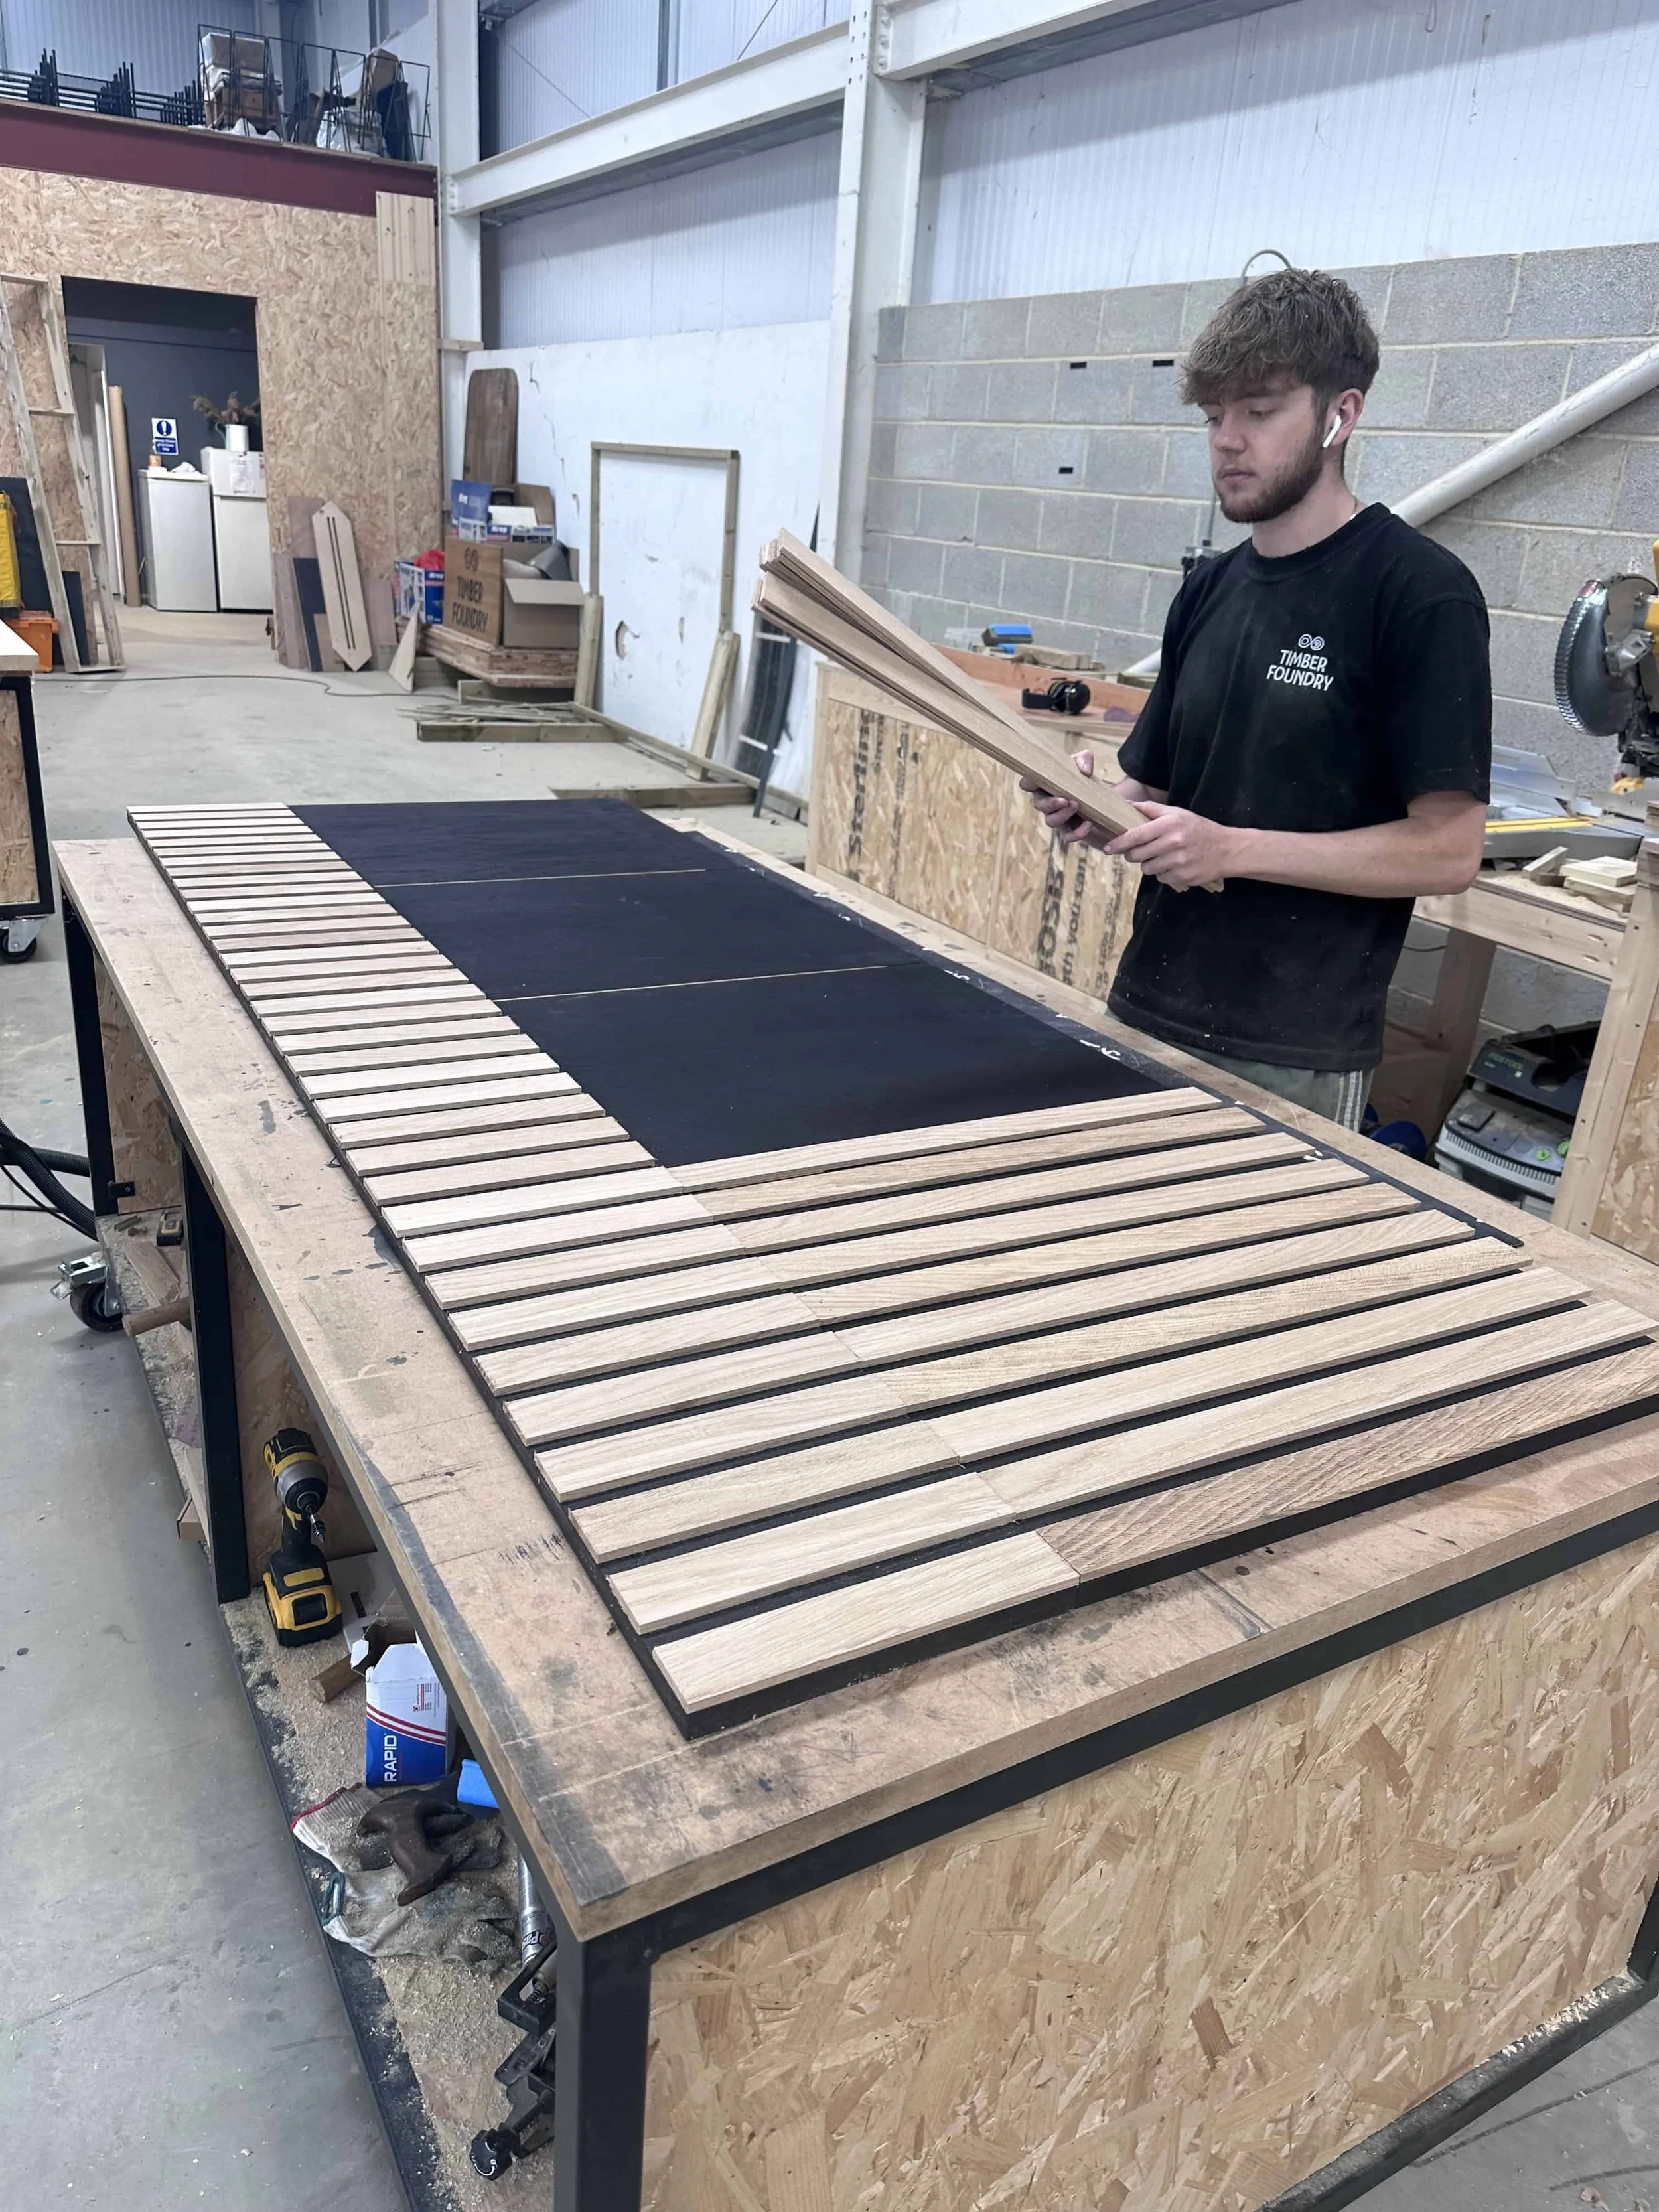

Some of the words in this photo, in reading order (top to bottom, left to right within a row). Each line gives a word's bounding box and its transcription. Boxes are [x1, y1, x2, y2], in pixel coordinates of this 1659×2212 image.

[457, 575, 484, 604] TIMBER
[453, 601, 489, 634] FOUNDRY
[1280, 649, 1328, 672] TIMBER
[1266, 664, 1334, 692] FOUNDRY
[1067, 903, 1080, 944] you
[1074, 857, 1087, 897] can
[383, 1734, 398, 1782] RAPID
